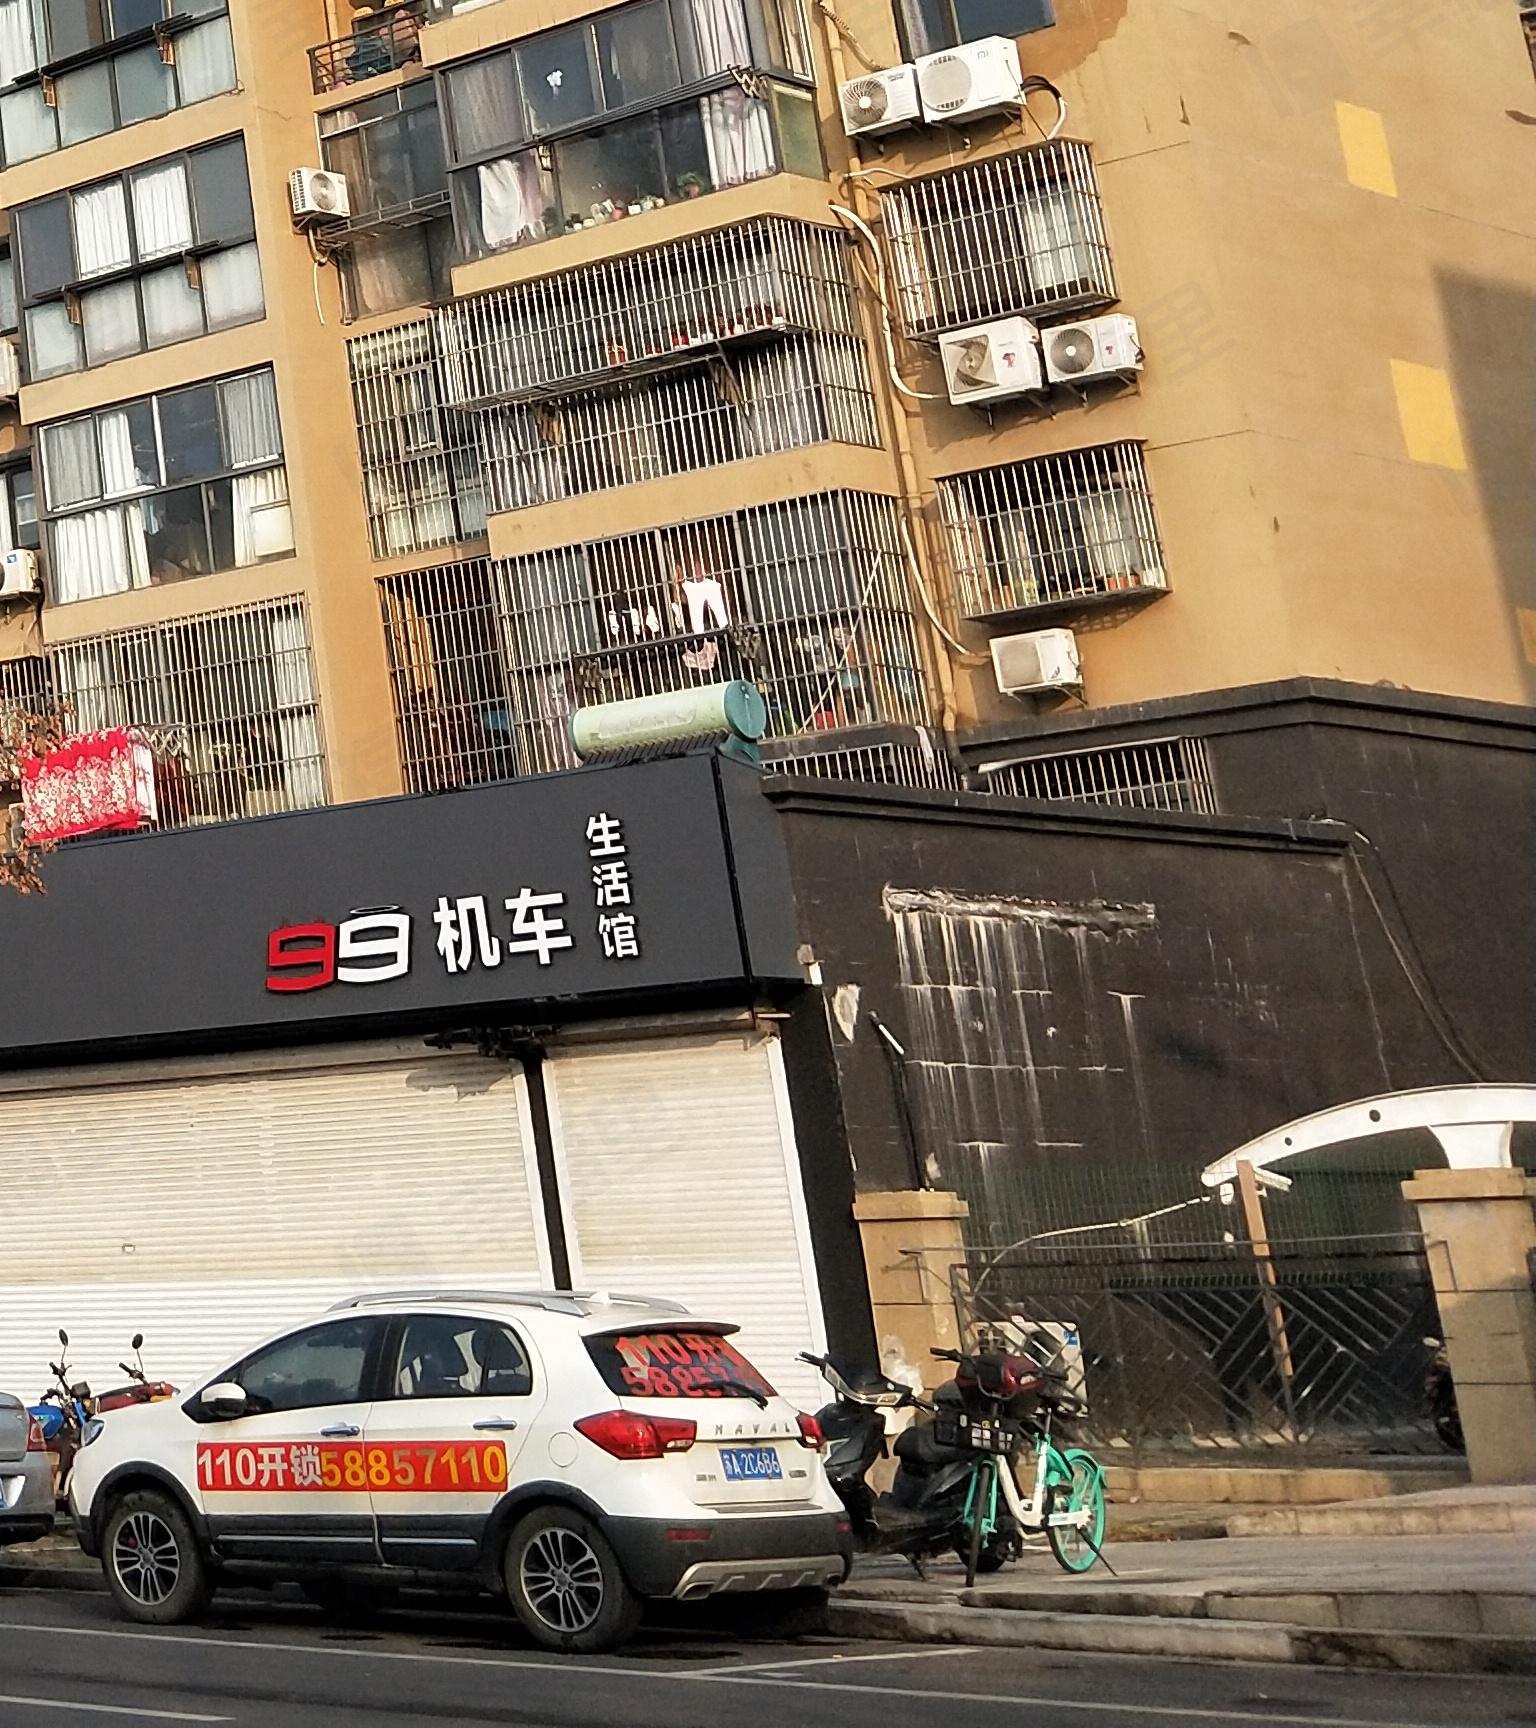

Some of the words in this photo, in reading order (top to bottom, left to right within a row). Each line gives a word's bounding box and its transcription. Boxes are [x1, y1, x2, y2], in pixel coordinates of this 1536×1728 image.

[433, 888, 573, 973] 机车
[586, 812, 640, 959] 生活馆
